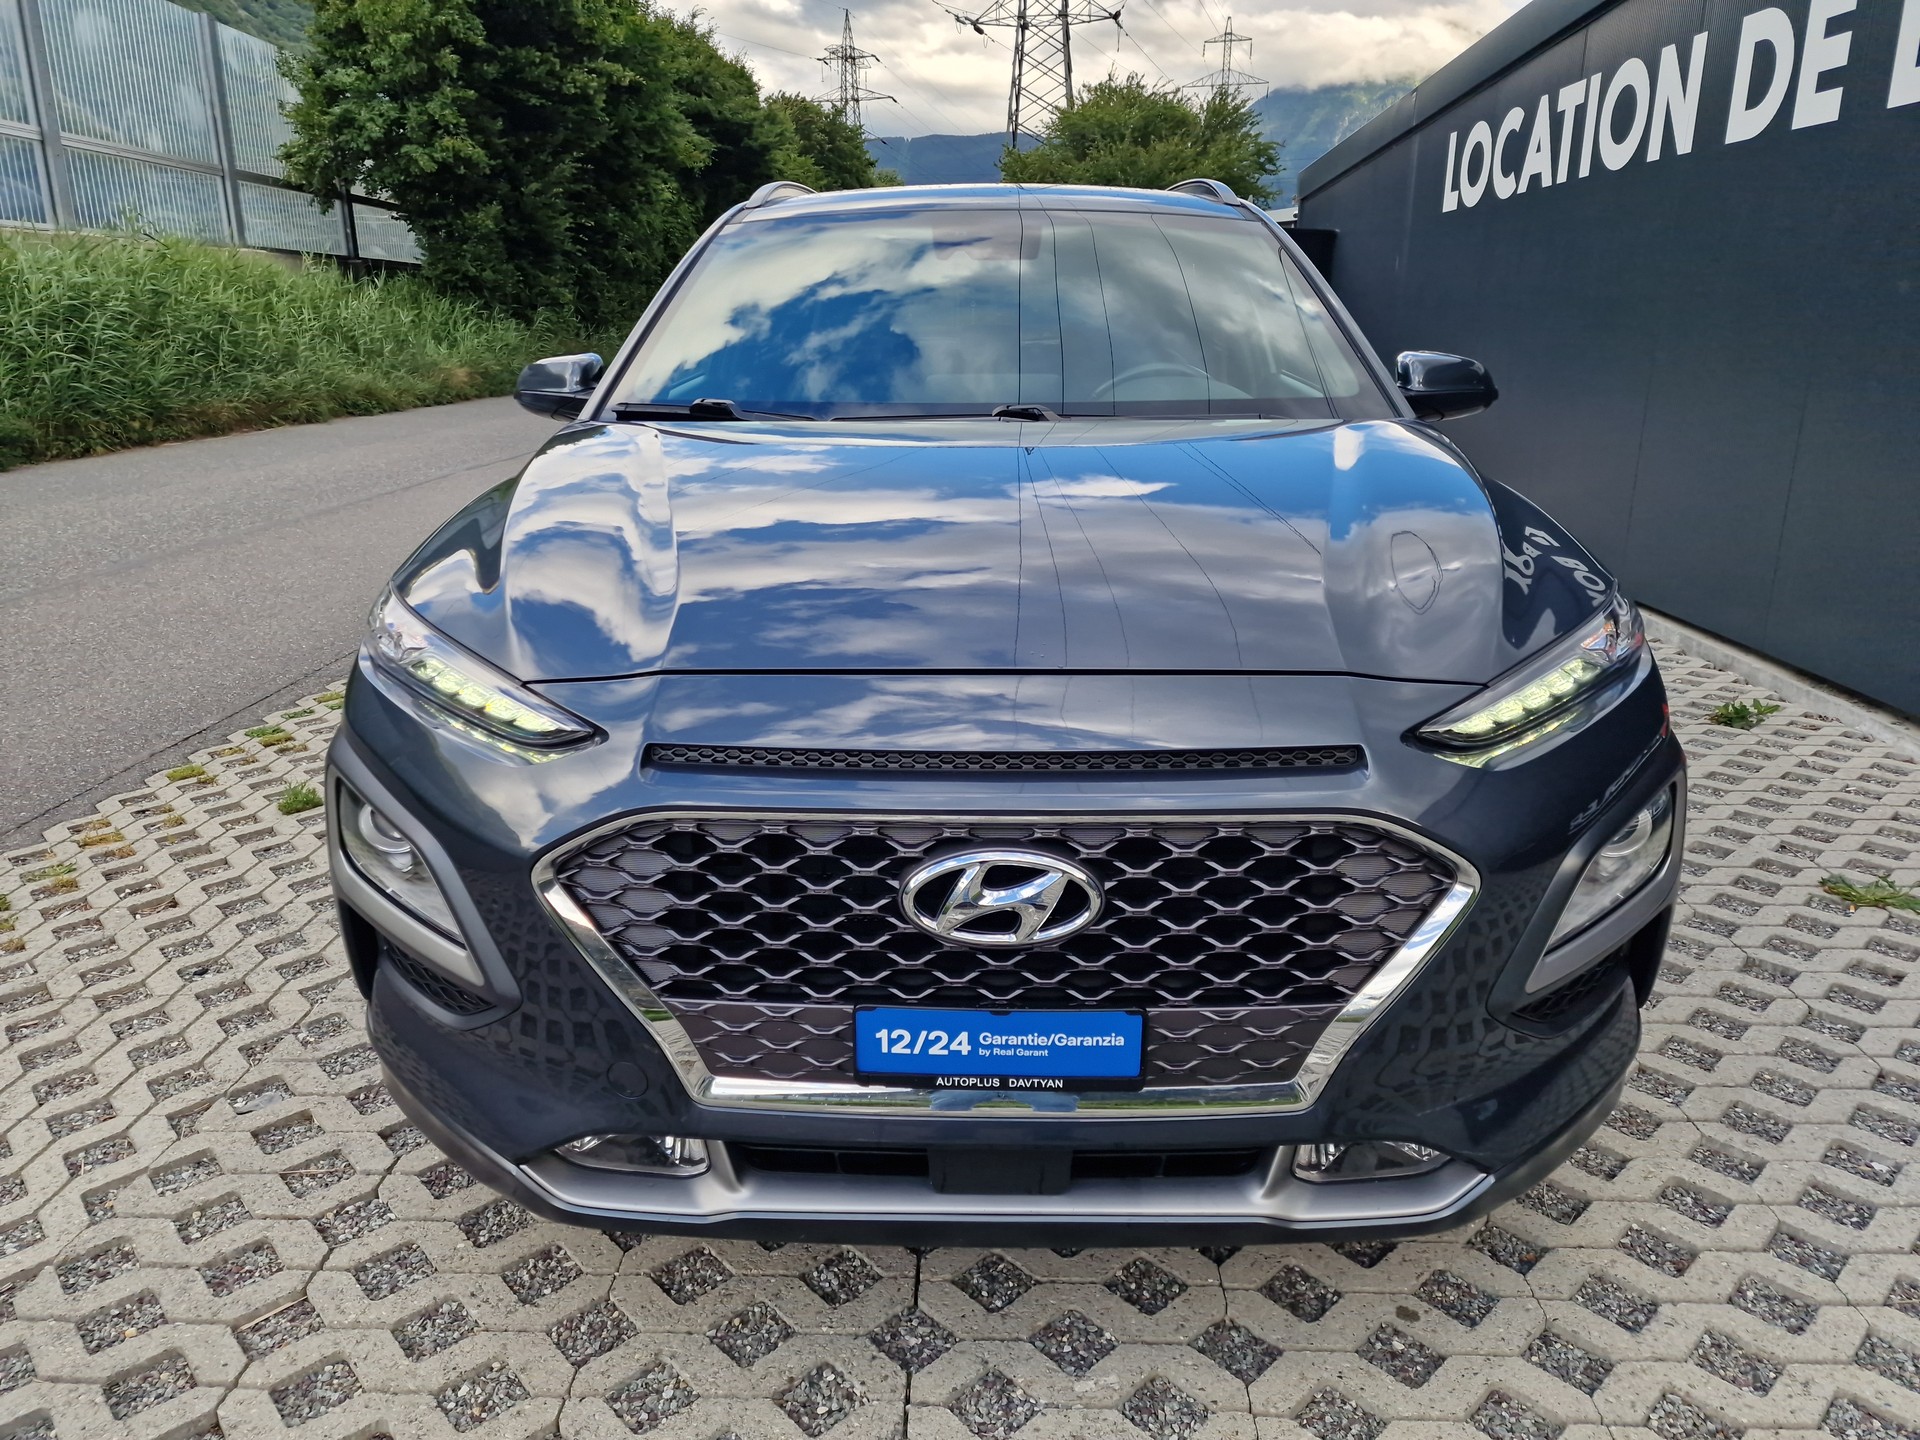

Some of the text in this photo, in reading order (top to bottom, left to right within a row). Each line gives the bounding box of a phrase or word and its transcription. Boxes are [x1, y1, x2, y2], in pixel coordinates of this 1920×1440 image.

[1442, 31, 1708, 213] LOCATION
[1725, 0, 1857, 145] DE
[875, 1028, 1125, 1056] 12/24 Garantie/Garanzia
[978, 1047, 1049, 1058] by Real Garant
[936, 1076, 1063, 1088] AUTOPLUS DAVTYAN
